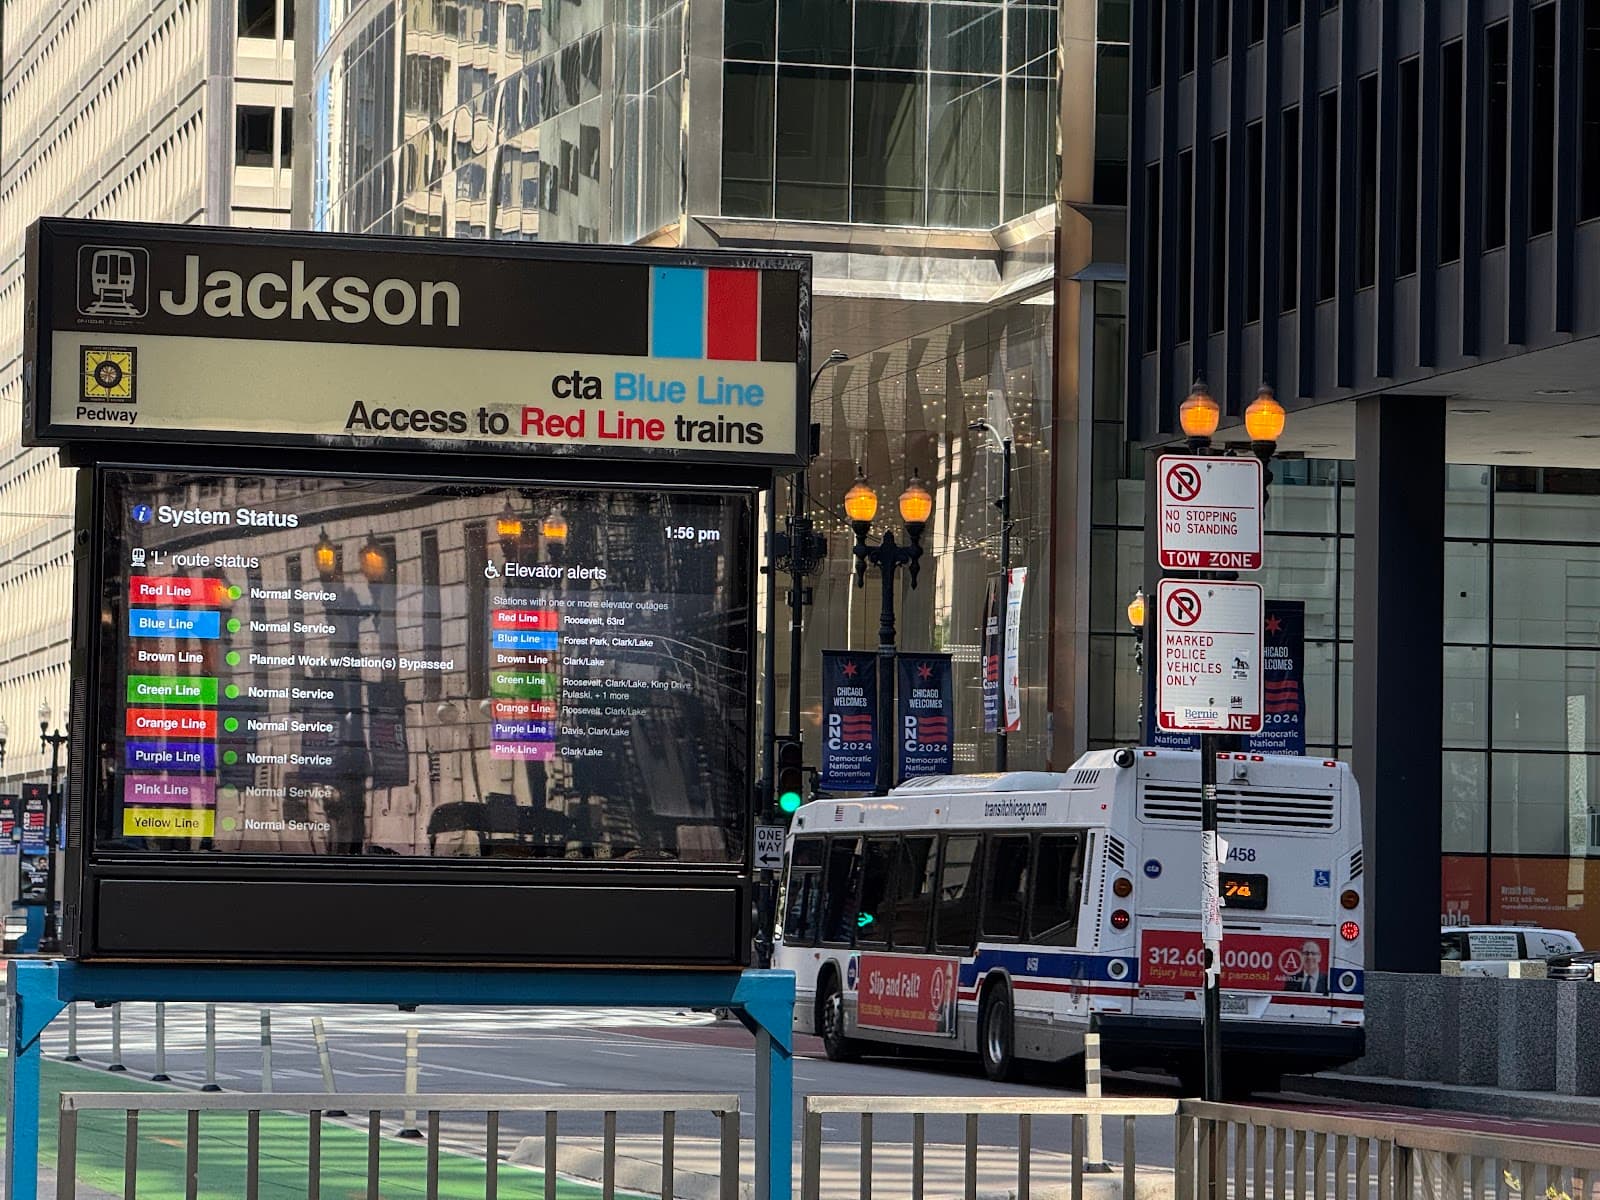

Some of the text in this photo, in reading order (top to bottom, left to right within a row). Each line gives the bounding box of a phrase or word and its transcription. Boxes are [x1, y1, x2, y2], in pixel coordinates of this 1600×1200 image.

[159, 254, 461, 327] Jackson
[551, 370, 765, 406] cta Blue Line
[76, 406, 138, 425] Pedway
[345, 400, 764, 445] Access to Red Line trains
[158, 505, 299, 528] System Status
[1166, 510, 1237, 522] NO STOPPING
[664, 526, 720, 543] 1:56 pm
[1166, 523, 1238, 535] NO STANDING
[172, 553, 210, 567] route
[214, 553, 259, 568] status
[1166, 551, 1253, 567] TOW ZONE
[504, 562, 607, 580] Elevator alerts
[140, 584, 192, 596] Red Line
[250, 587, 337, 601] Normal Service
[494, 595, 527, 605] Stations
[529, 596, 547, 606] with
[548, 599, 565, 607] one
[577, 600, 599, 608] more
[601, 600, 634, 609] elevator
[636, 601, 669, 611] outages
[139, 617, 194, 630] Blue Line
[498, 612, 538, 623] Red Line
[563, 616, 625, 626] Roosevelt, 63rd
[249, 621, 336, 633] Normal Service
[498, 633, 541, 644] Blue Line
[563, 636, 654, 647] Forest Park, Clark/Lake
[1166, 635, 1214, 647] MARKED
[138, 650, 204, 663] Brown Line
[497, 654, 548, 665] Brown Line
[1166, 648, 1206, 660] POLICE
[249, 653, 454, 671] Planned Work w/Station(s) Bypassed
[563, 656, 605, 666] Clark/Lake
[1167, 661, 1222, 674] VEHICLES
[496, 675, 546, 685] Green Line
[562, 678, 604, 688] Roosevelt,
[605, 679, 650, 690] Clark/Lake,
[651, 680, 669, 691] King
[1166, 674, 1197, 686] ONLY
[137, 683, 201, 696] Green Line
[248, 686, 334, 700] Normal Service
[562, 690, 593, 701] Pulaski,
[602, 691, 607, 700] 1
[609, 693, 630, 701] more
[836, 686, 864, 697] CHICAGO
[912, 688, 939, 699] CHICAGO
[833, 697, 868, 707] WELCOMES
[909, 698, 943, 709] WELCOMES
[496, 703, 551, 714] Orange Line
[562, 706, 647, 717] Roosevelt, Clark/Lake
[1184, 708, 1219, 719] Bernie
[136, 717, 207, 731] Orange Line
[1264, 714, 1298, 723] 2024
[247, 719, 288, 731] Normal
[291, 720, 334, 733] Service
[496, 724, 546, 735] Purple Line
[562, 726, 630, 737] Davis, Clark/Lake
[842, 742, 873, 750] 2024
[1154, 735, 1191, 745] National
[1249, 739, 1286, 748] National
[495, 744, 537, 754] Pink Line
[561, 747, 603, 757] Clark/Lake
[918, 743, 948, 752] 2024
[135, 750, 201, 764] Purple Line
[246, 752, 333, 765] Normal Service
[829, 754, 872, 762] Democratic
[905, 756, 948, 764] Democratic
[829, 762, 860, 770] National
[904, 764, 936, 772] National
[135, 783, 189, 795] Pink Line
[245, 785, 332, 798] Normal Service
[984, 798, 1048, 821] transitchicago.com
[134, 816, 199, 829] Yellow Line
[245, 818, 331, 831] Normal Service
[758, 829, 782, 840] ONE
[757, 841, 782, 852] WAY
[1226, 847, 1256, 862] 458
[1225, 885, 1251, 897] 74
[1285, 952, 1298, 969] A
[1149, 965, 1177, 980] Injury
[1180, 967, 1198, 977] law
[1228, 972, 1271, 982] personal
[869, 970, 921, 1000] Slip and Fall?
